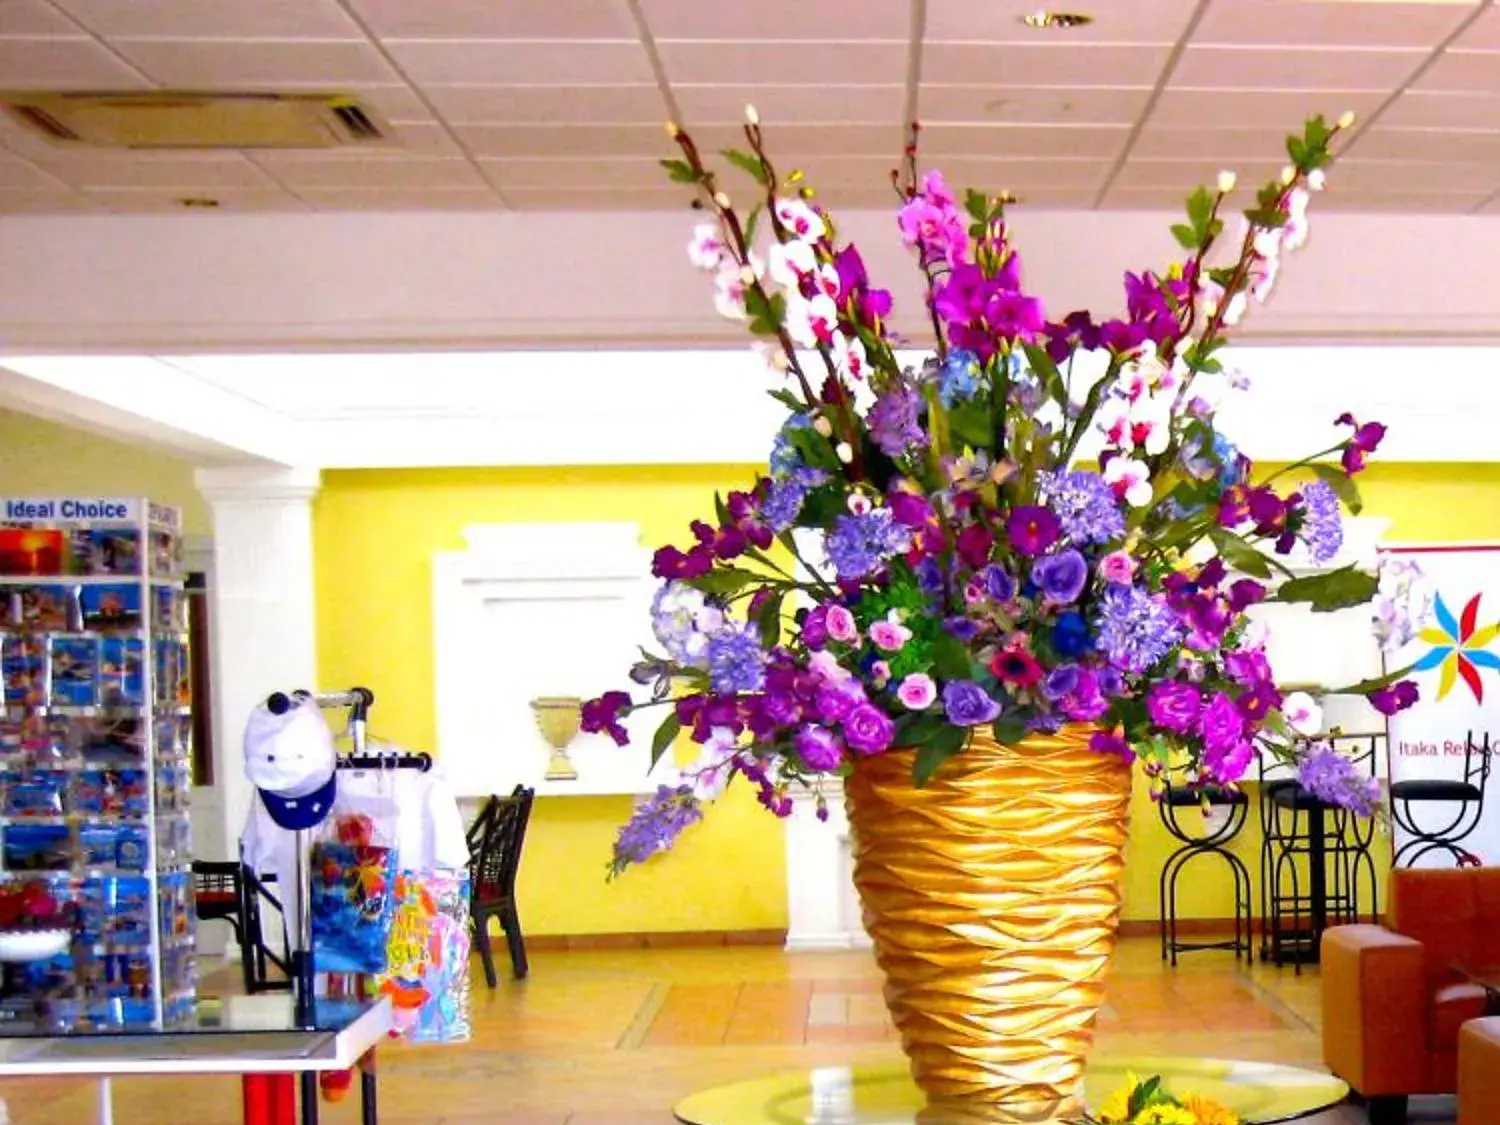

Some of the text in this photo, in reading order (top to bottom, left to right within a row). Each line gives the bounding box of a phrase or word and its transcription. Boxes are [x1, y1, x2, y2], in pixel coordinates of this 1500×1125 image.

[7, 500, 54, 518] Ideal
[61, 500, 128, 518] Choice
[1399, 741, 1439, 756] Itaka
[1443, 740, 1486, 756] Rel
